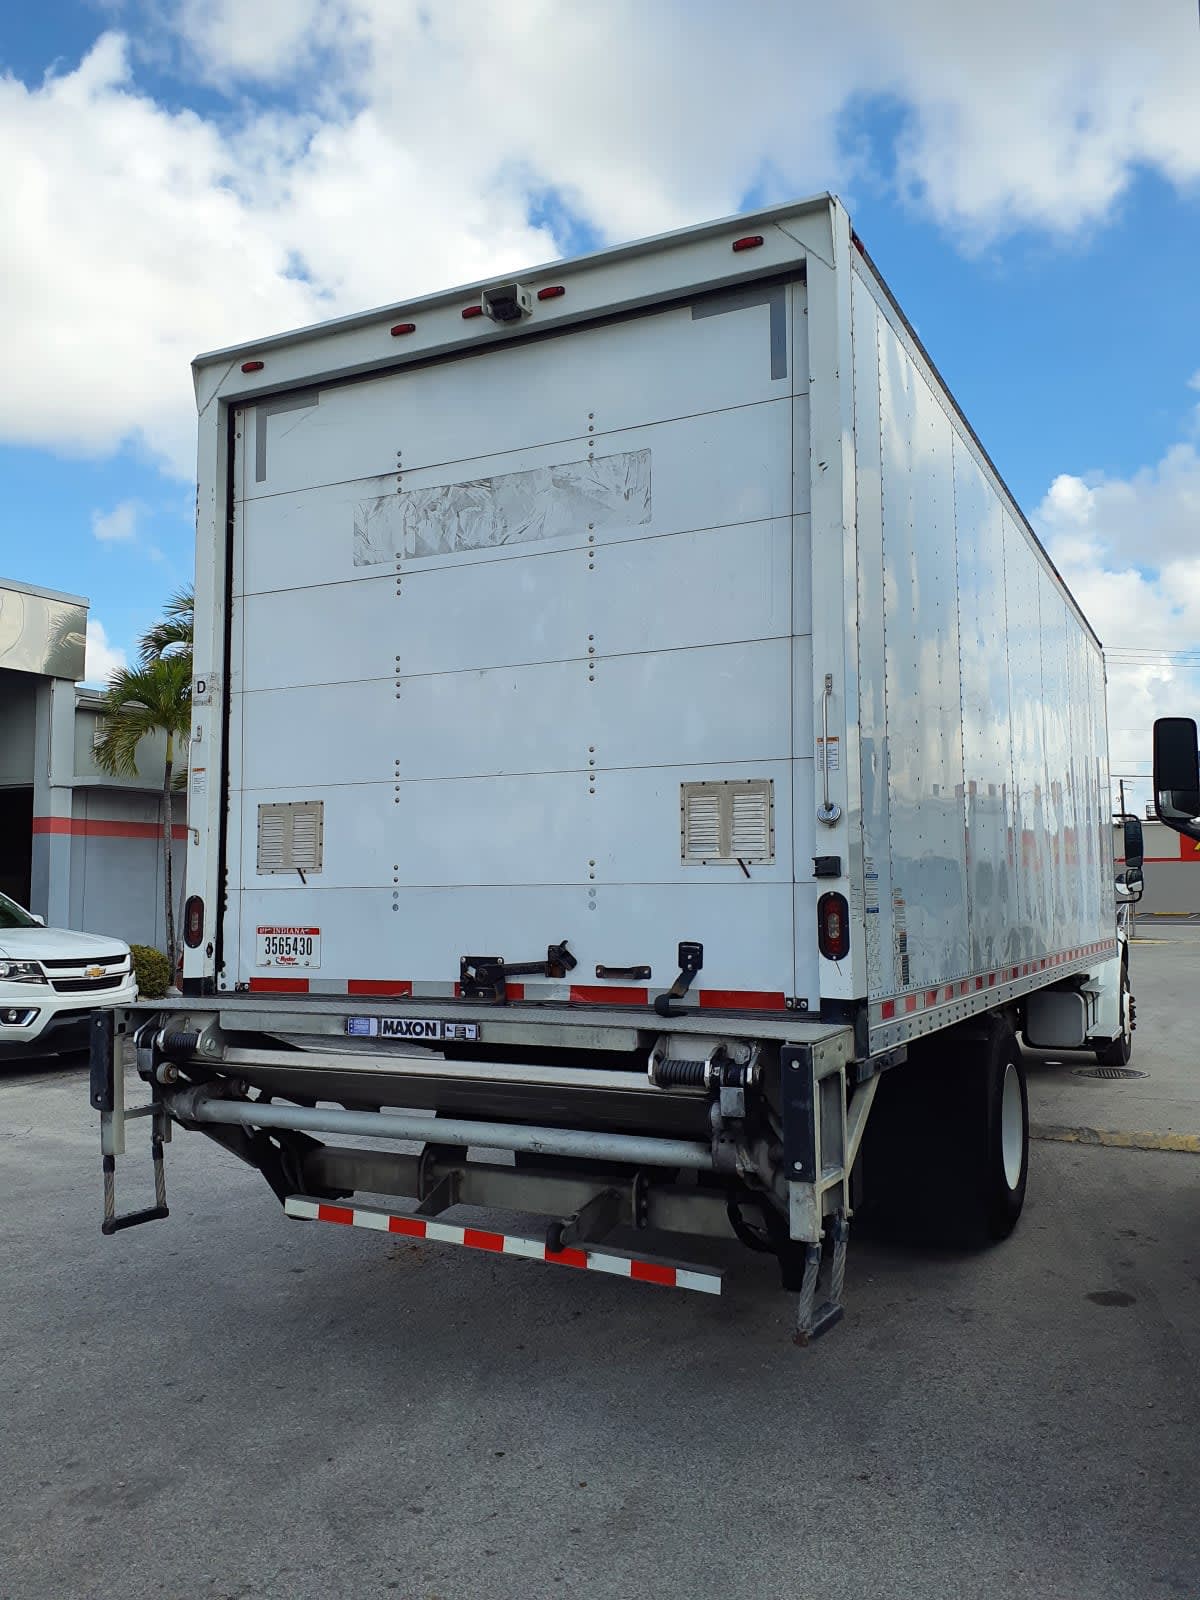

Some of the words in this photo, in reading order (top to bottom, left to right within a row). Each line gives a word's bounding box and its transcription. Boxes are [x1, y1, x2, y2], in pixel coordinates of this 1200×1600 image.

[197, 680, 206, 694] D
[265, 936, 312, 956] 3565430
[382, 1020, 437, 1037] MAXON
